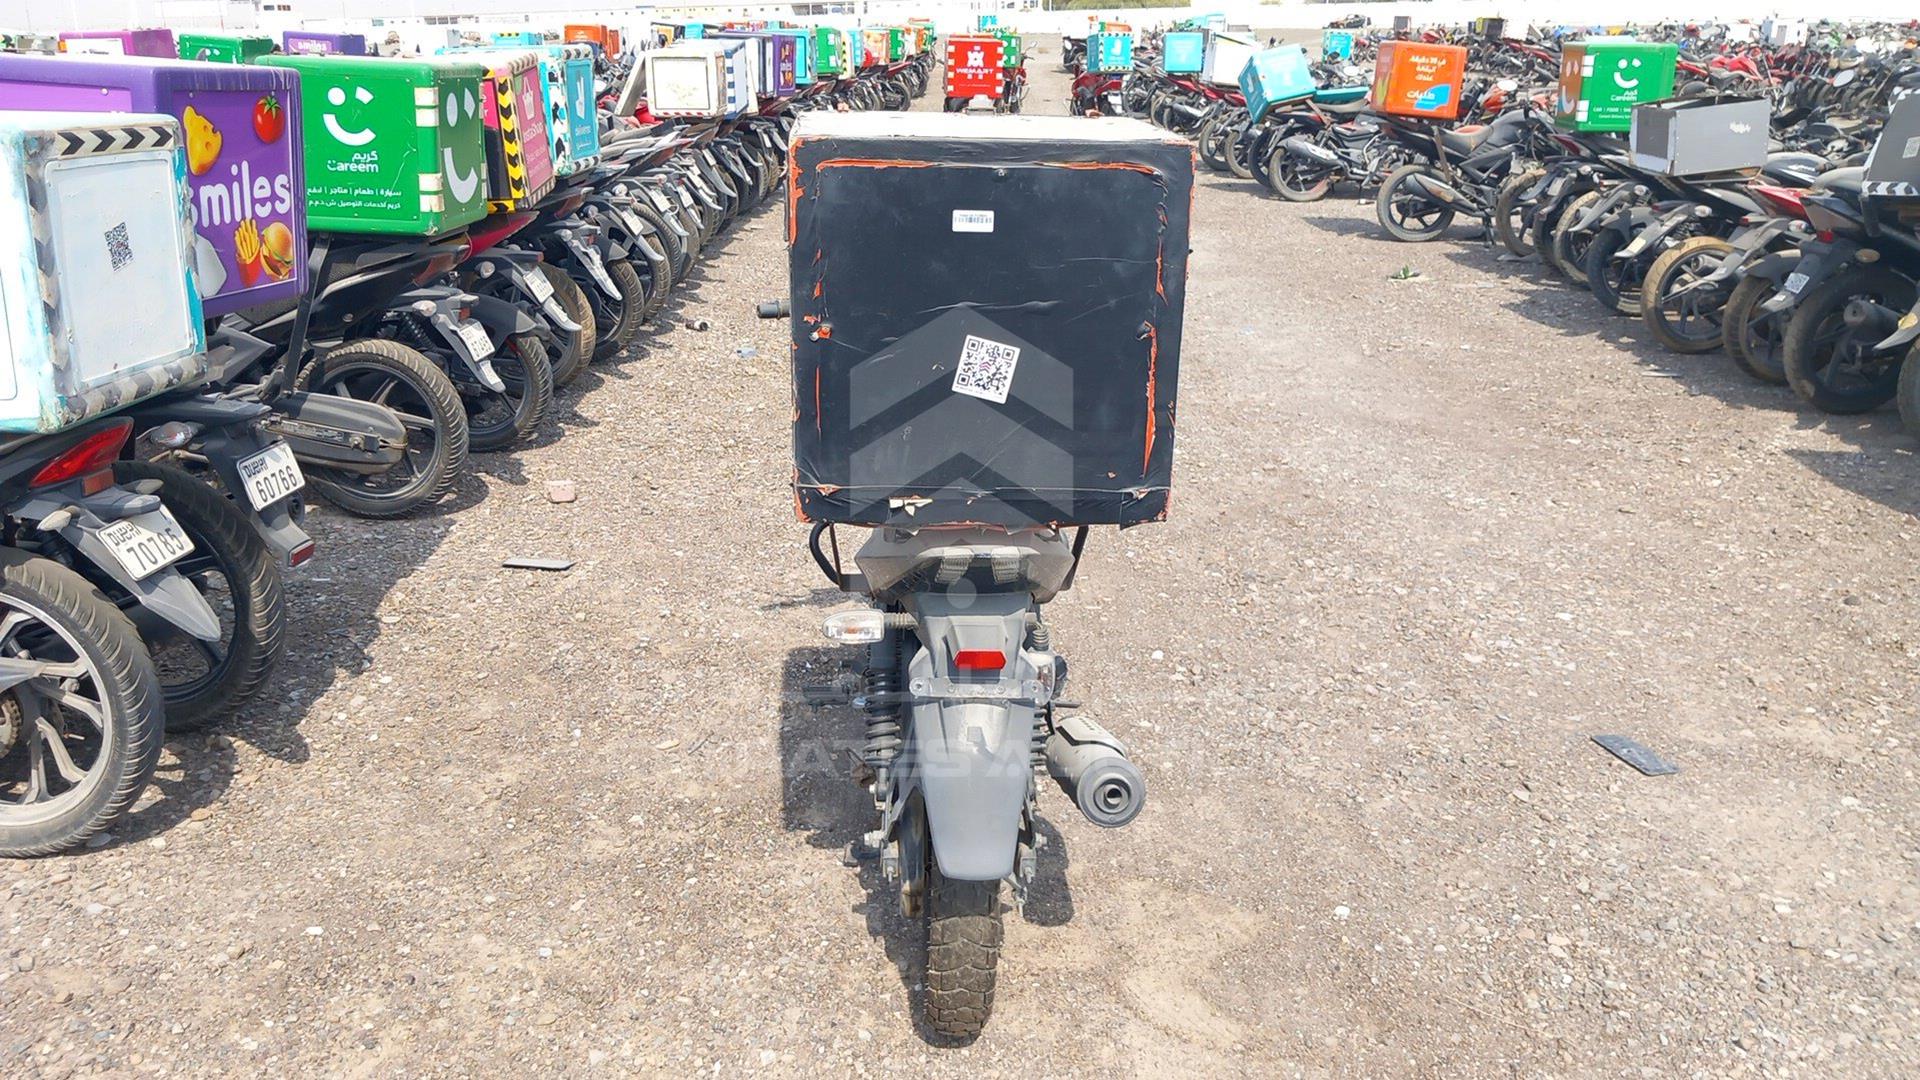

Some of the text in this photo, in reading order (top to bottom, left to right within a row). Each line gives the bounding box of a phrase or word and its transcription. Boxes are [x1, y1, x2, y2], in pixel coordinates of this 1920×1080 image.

[352, 150, 378, 162] كريم
[354, 187, 374, 197] طعام
[255, 465, 298, 503] 60766
[126, 527, 185, 572] 70785
